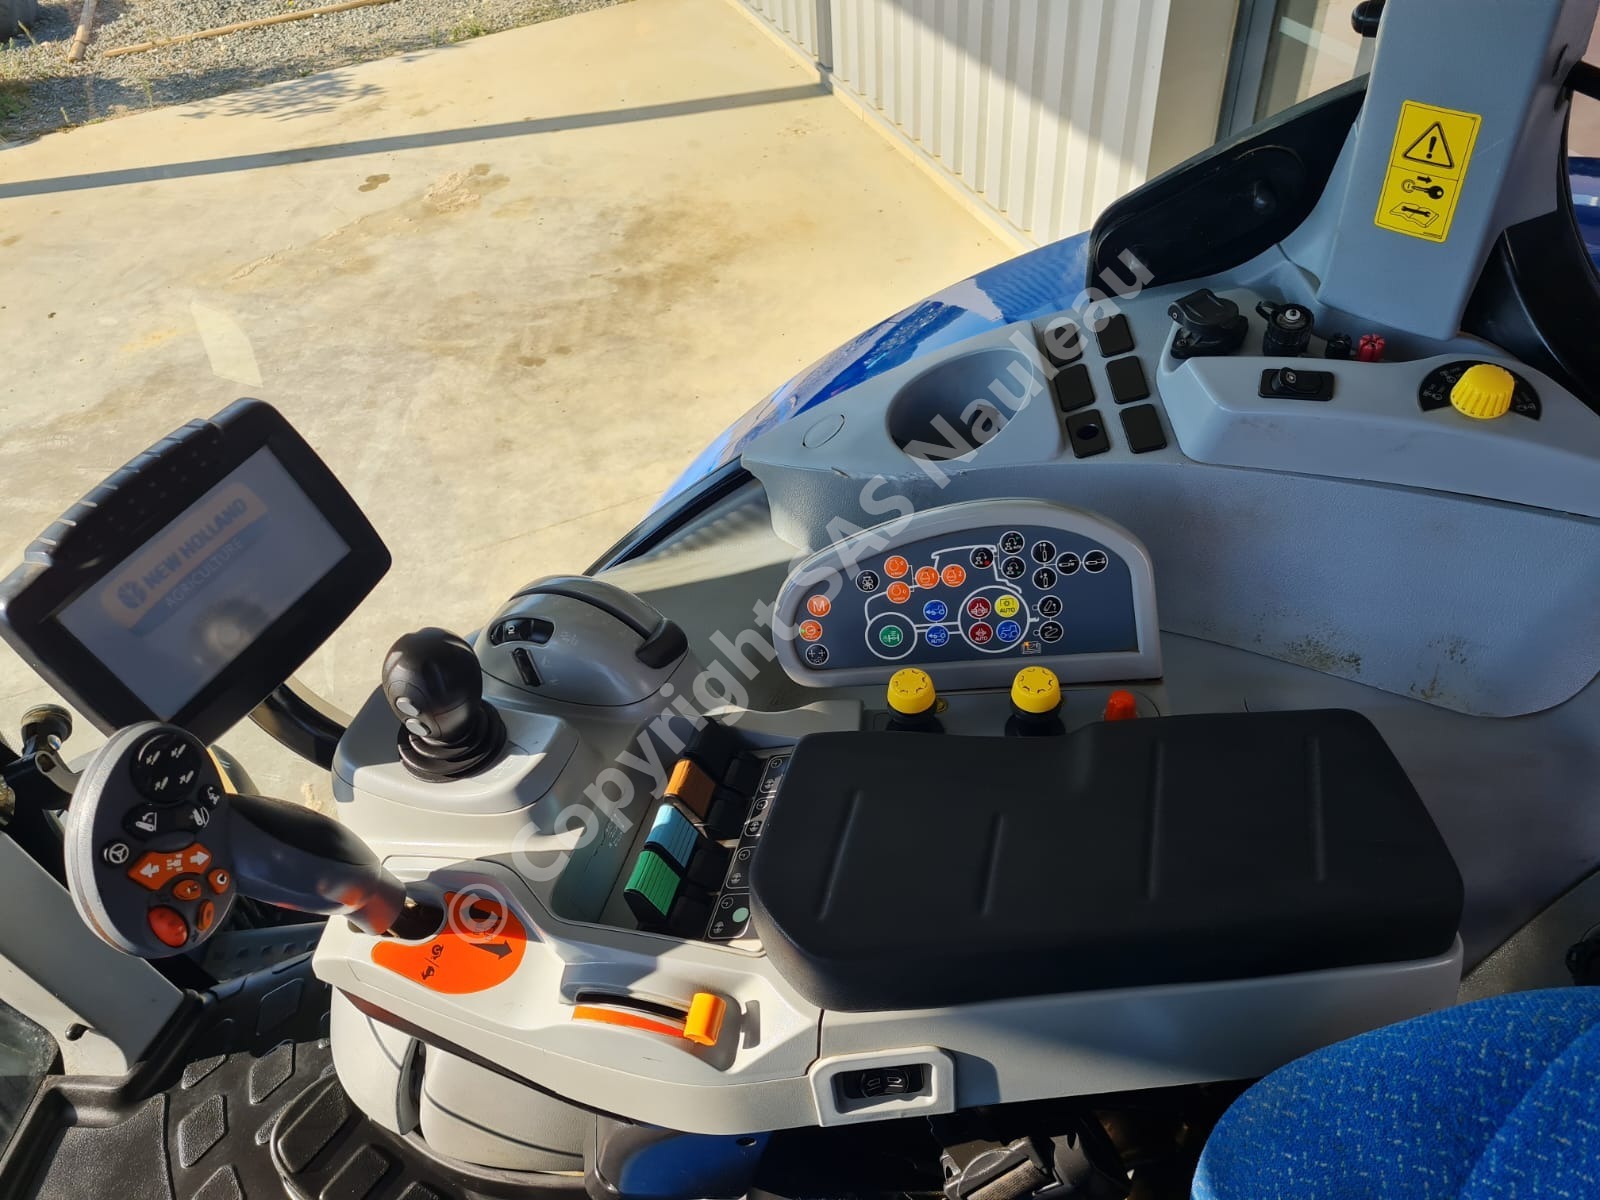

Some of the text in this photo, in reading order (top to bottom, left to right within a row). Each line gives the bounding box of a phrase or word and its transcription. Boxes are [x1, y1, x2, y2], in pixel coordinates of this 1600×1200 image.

[141, 497, 248, 590] NEW HOLLAND
[165, 538, 243, 609] AGRICULTURE
[812, 600, 827, 613] M
